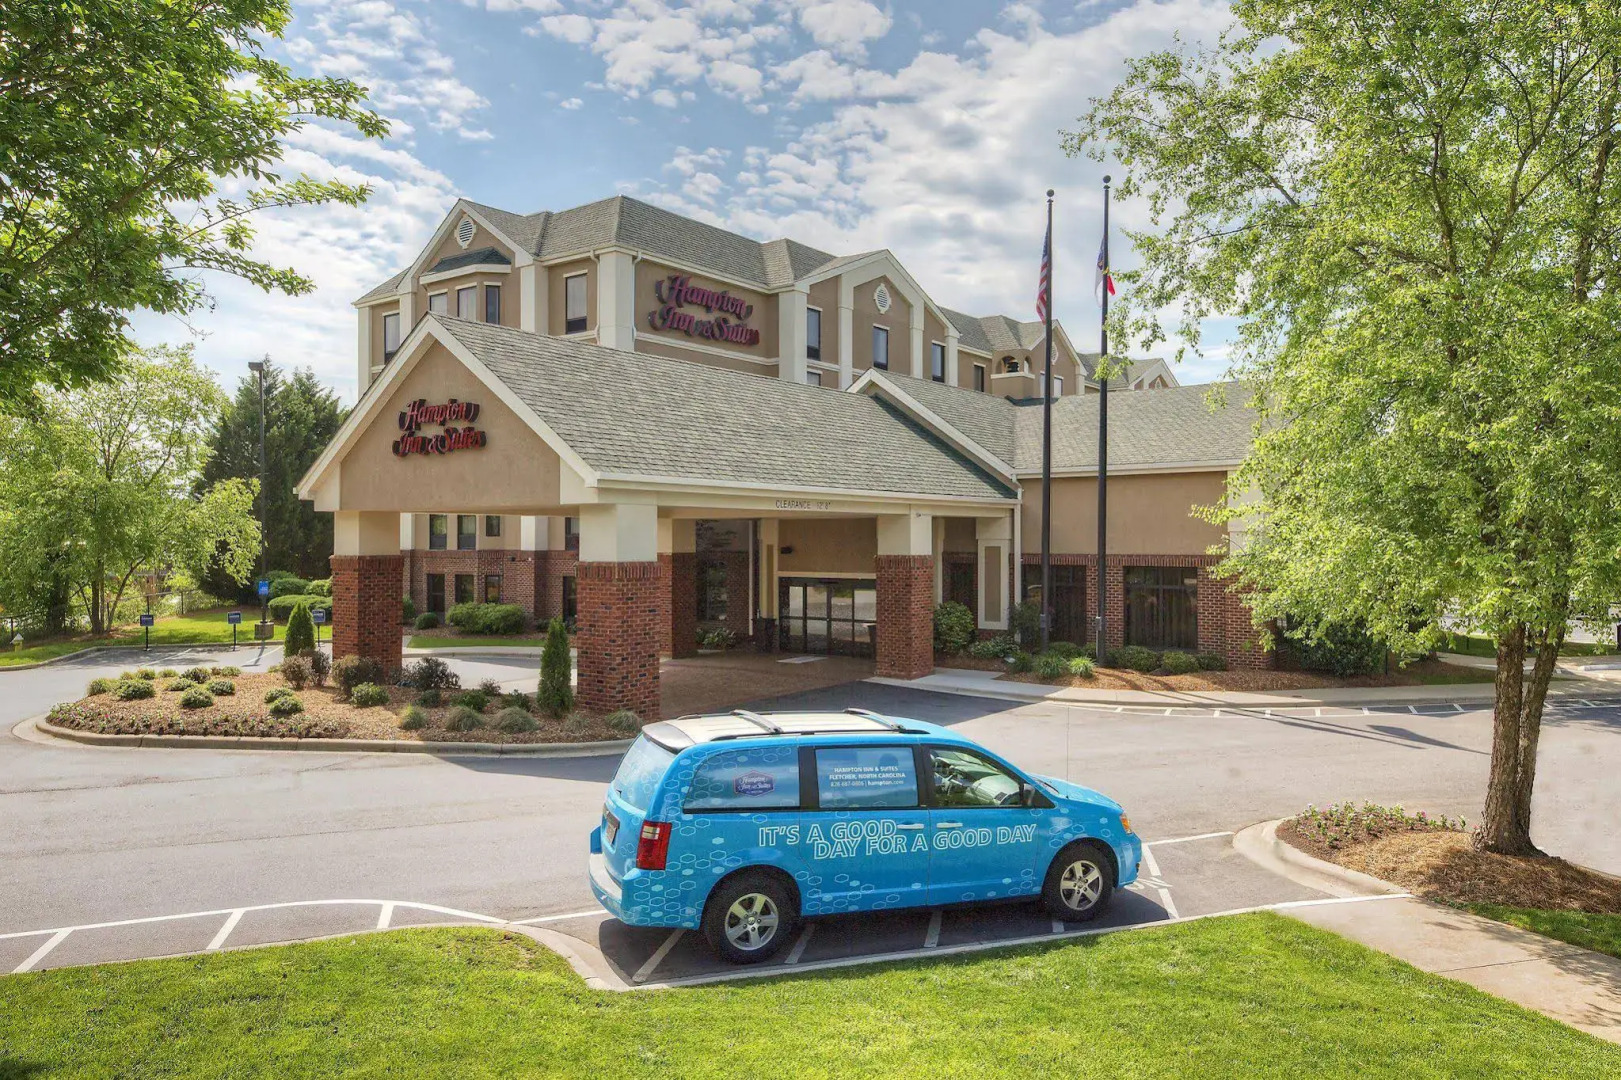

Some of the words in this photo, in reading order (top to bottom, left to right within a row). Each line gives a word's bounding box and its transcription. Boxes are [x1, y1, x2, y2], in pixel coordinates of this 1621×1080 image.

[654, 273, 754, 320] Hampton
[648, 304, 701, 337] Inn
[398, 398, 480, 431] Hampton
[391, 431, 430, 457] Inn
[775, 499, 811, 509] CLEARANCE
[759, 826, 800, 846] IT'S
[807, 824, 824, 844] A
[830, 819, 897, 841] GOOD
[814, 838, 860, 859] DAY
[865, 834, 907, 855] FOR
[911, 833, 929, 852] A
[933, 828, 992, 850] GOOD
[996, 823, 1037, 845] DAY
